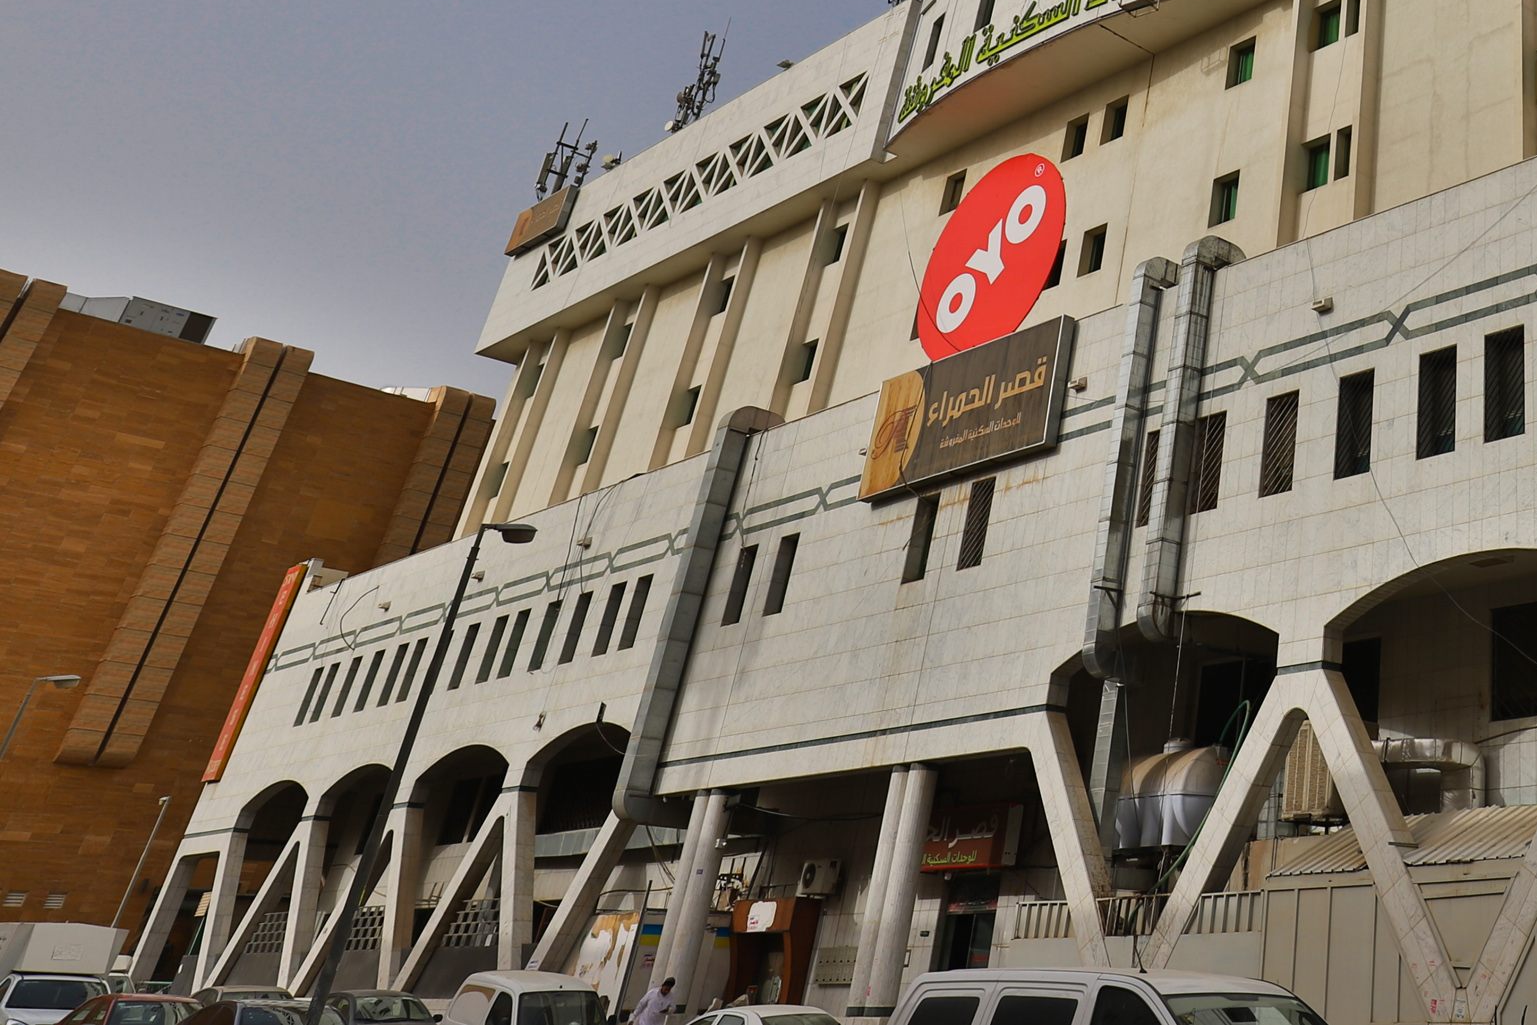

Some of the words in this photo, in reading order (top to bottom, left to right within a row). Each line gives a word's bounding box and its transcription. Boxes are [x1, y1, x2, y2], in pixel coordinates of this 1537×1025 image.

[935, 184, 1047, 334] OYO
[926, 373, 996, 427] الحمراء
[994, 356, 1048, 410] قصر
[948, 808, 999, 849] قصر
